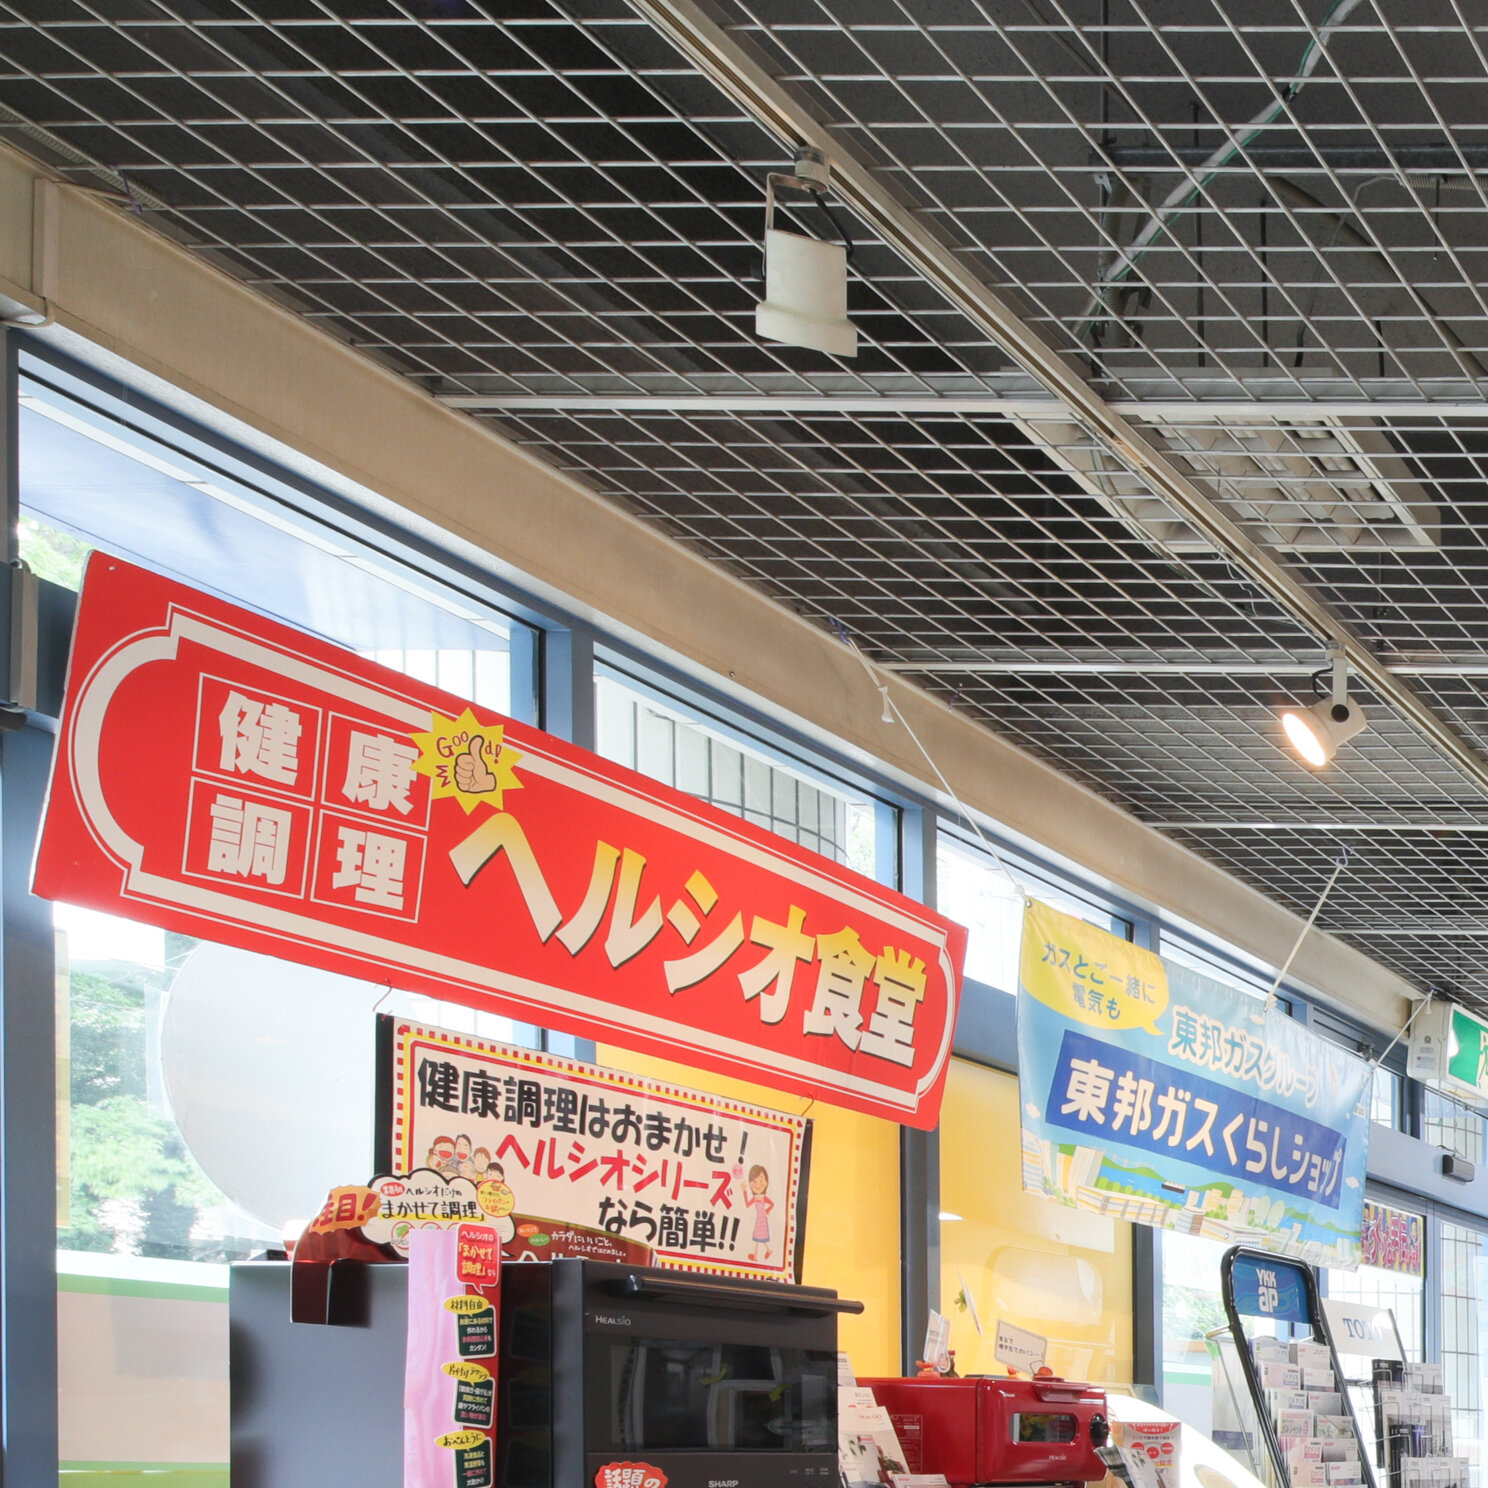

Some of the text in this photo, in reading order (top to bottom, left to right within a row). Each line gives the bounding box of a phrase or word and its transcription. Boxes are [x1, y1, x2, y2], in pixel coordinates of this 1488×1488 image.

[218, 691, 419, 817] 健康
[207, 795, 408, 911] 調理
[449, 812, 930, 1069] ヘルシオ食堂
[1040, 940, 1157, 1006] ガスとご一緒に
[1071, 982, 1122, 1021] 電気も
[1059, 1055, 1347, 1199] 東邦ガスくらしショップ
[495, 1133, 734, 1210] ヘルシオシリーズ
[1255, 1268, 1277, 1286] YKK
[442, 1432, 483, 1447] おべんとうに
[708, 1480, 739, 1488] SHARP
